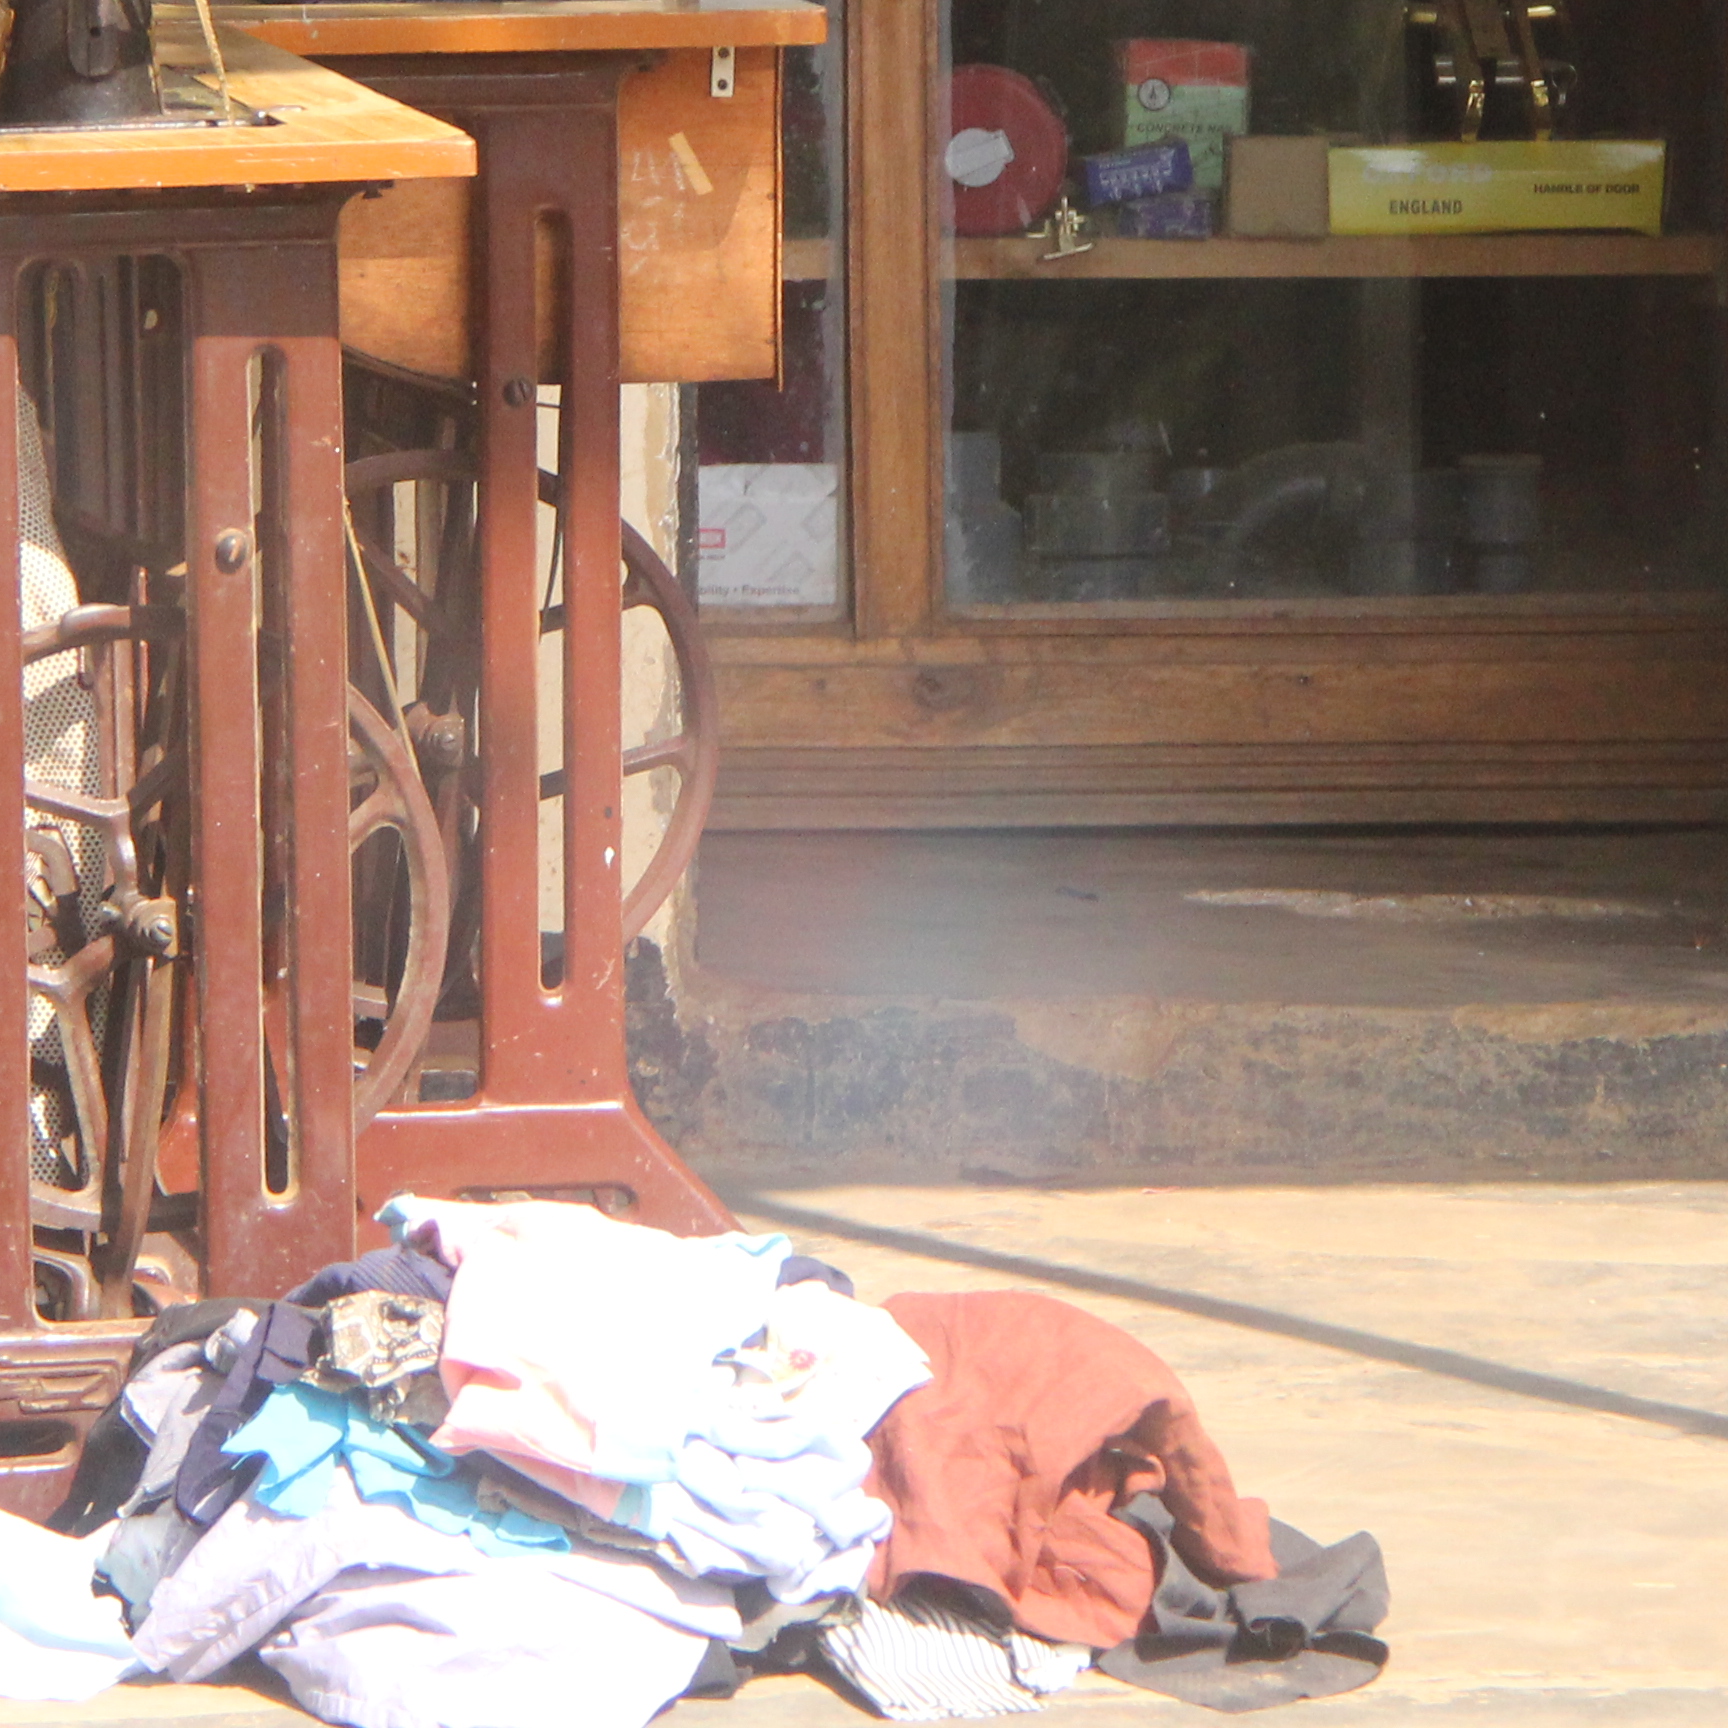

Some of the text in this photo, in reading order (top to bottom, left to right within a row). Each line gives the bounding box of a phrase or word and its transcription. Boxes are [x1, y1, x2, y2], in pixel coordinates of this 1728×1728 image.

[1534, 183, 1640, 193] HANDLE OF DOOR
[1388, 199, 1464, 214] ENGLAND
